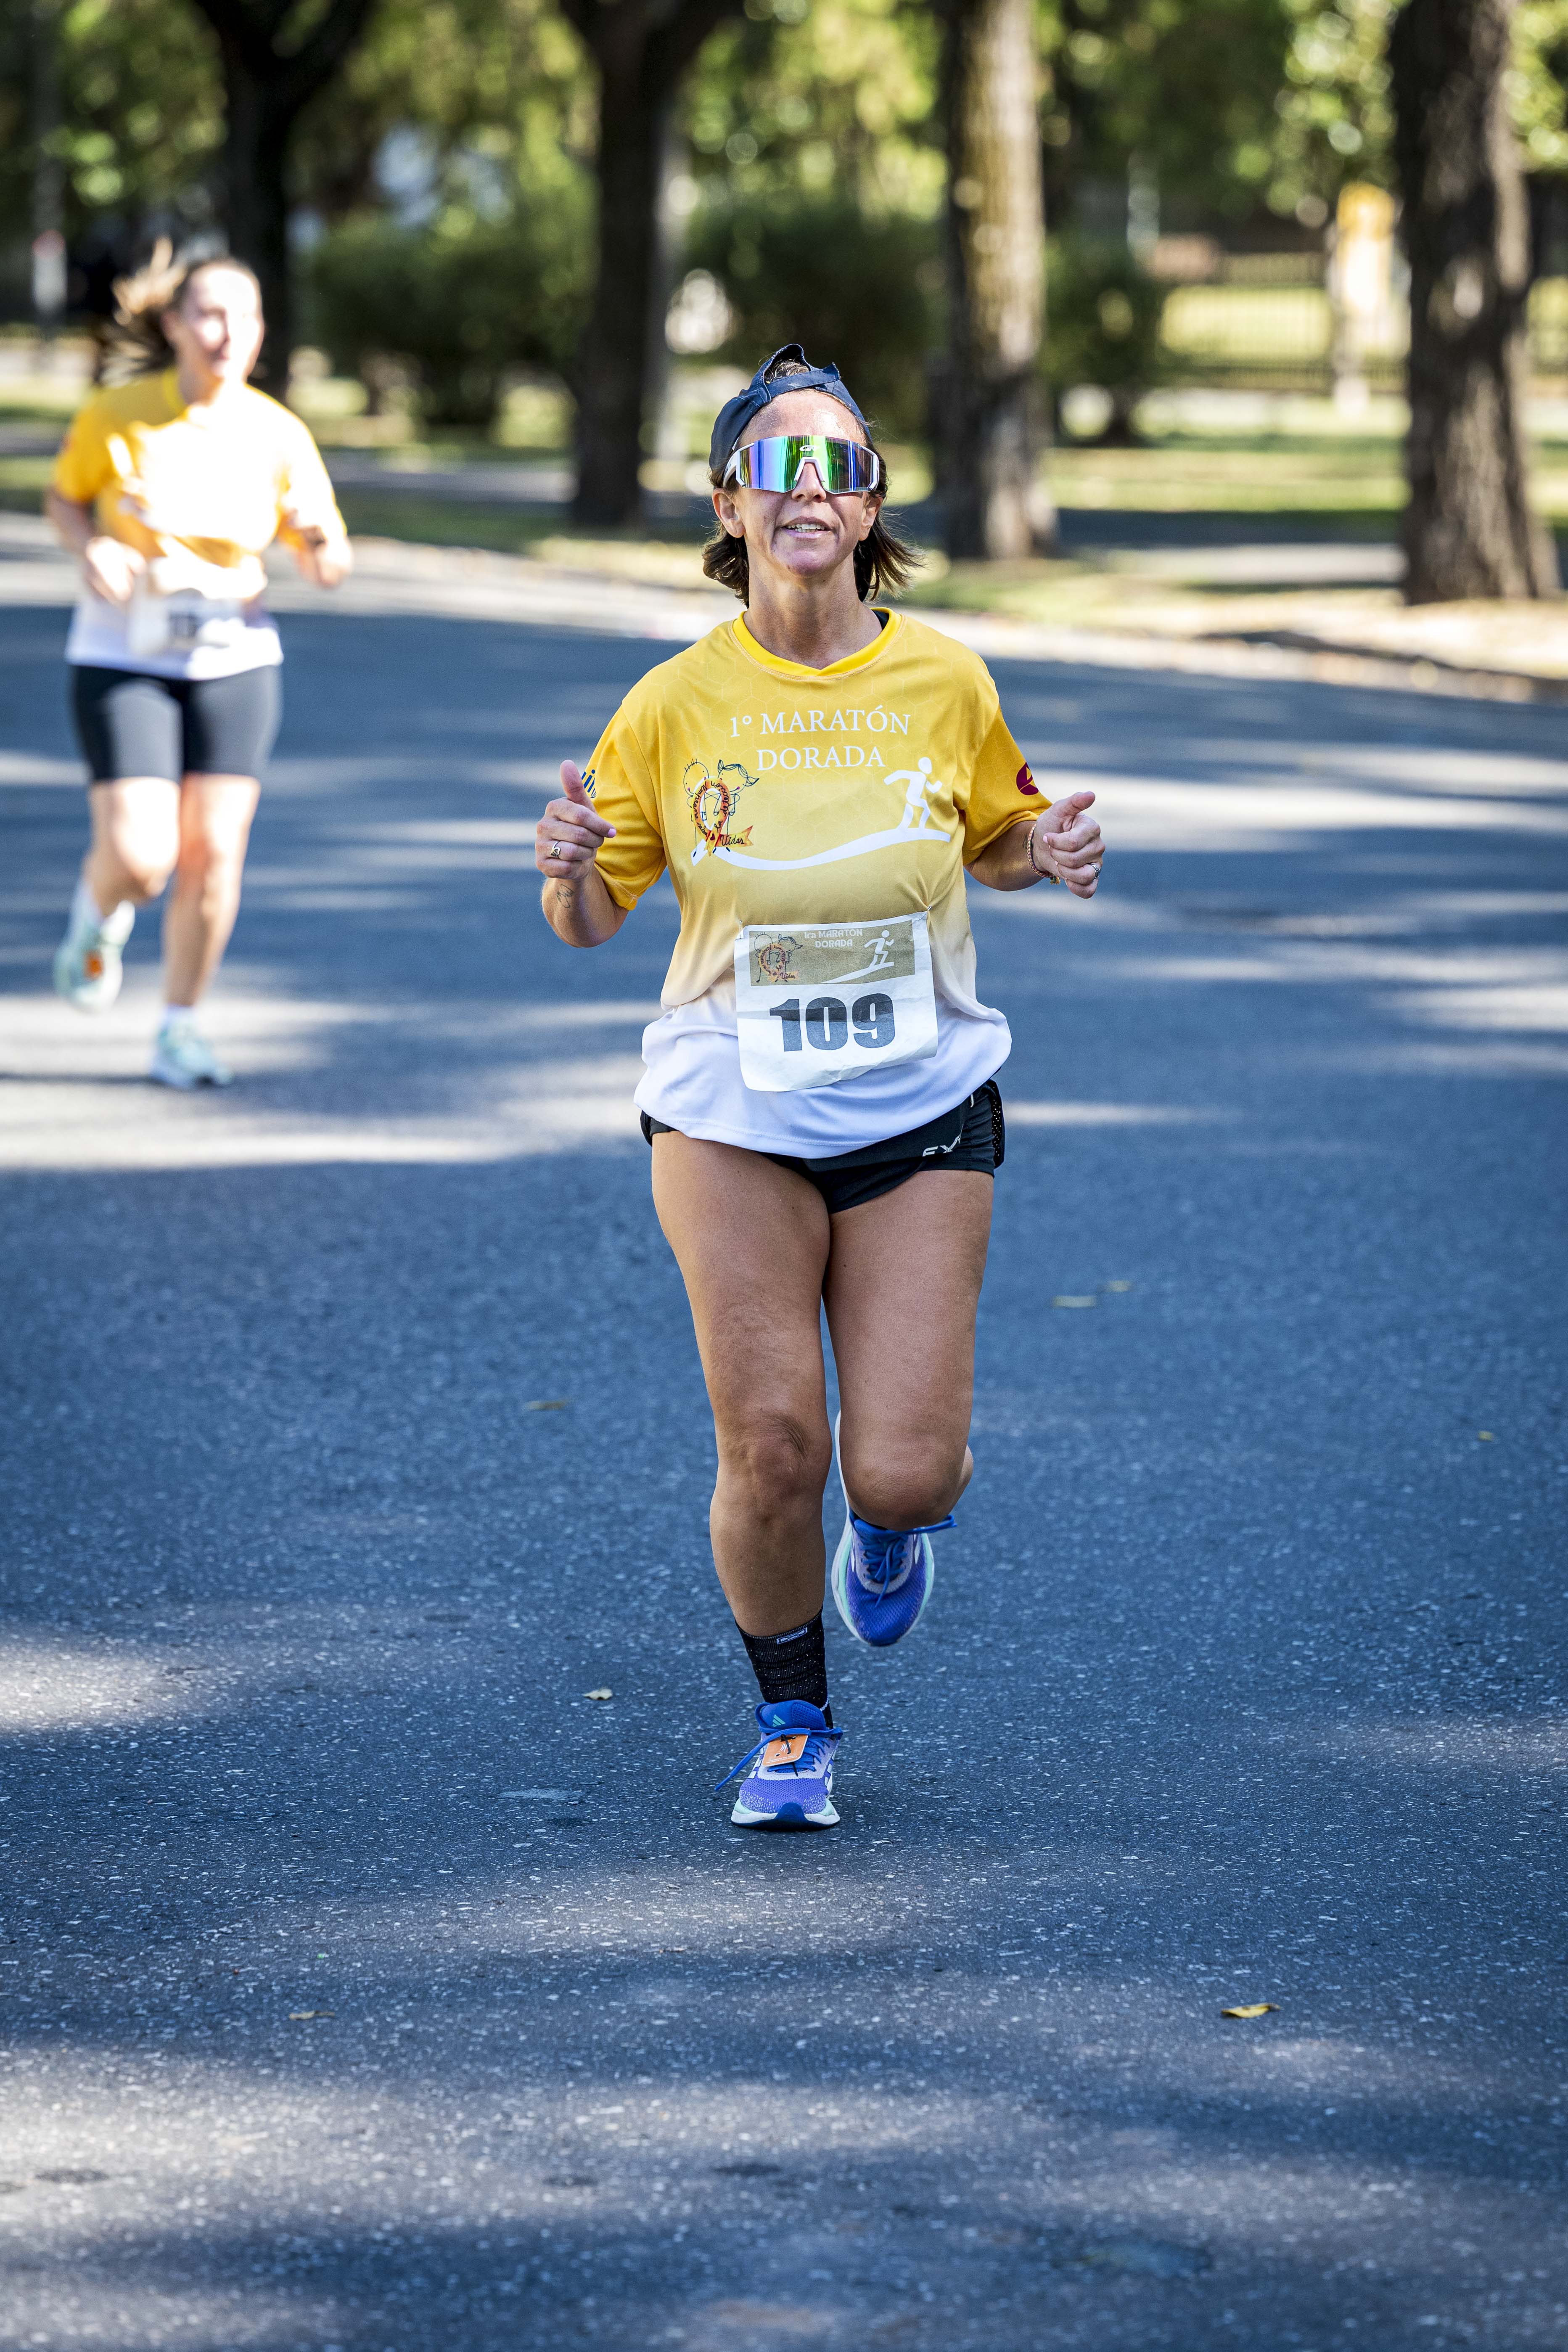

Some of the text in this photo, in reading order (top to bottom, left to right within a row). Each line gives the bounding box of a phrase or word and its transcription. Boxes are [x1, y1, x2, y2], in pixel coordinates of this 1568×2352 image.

[760, 705, 911, 735] MARATÓN
[757, 746, 886, 771] DORADA
[719, 834, 745, 846] Vidas
[818, 929, 863, 938] MARATON
[815, 939, 853, 948] DORADA
[769, 993, 895, 1052] 109
